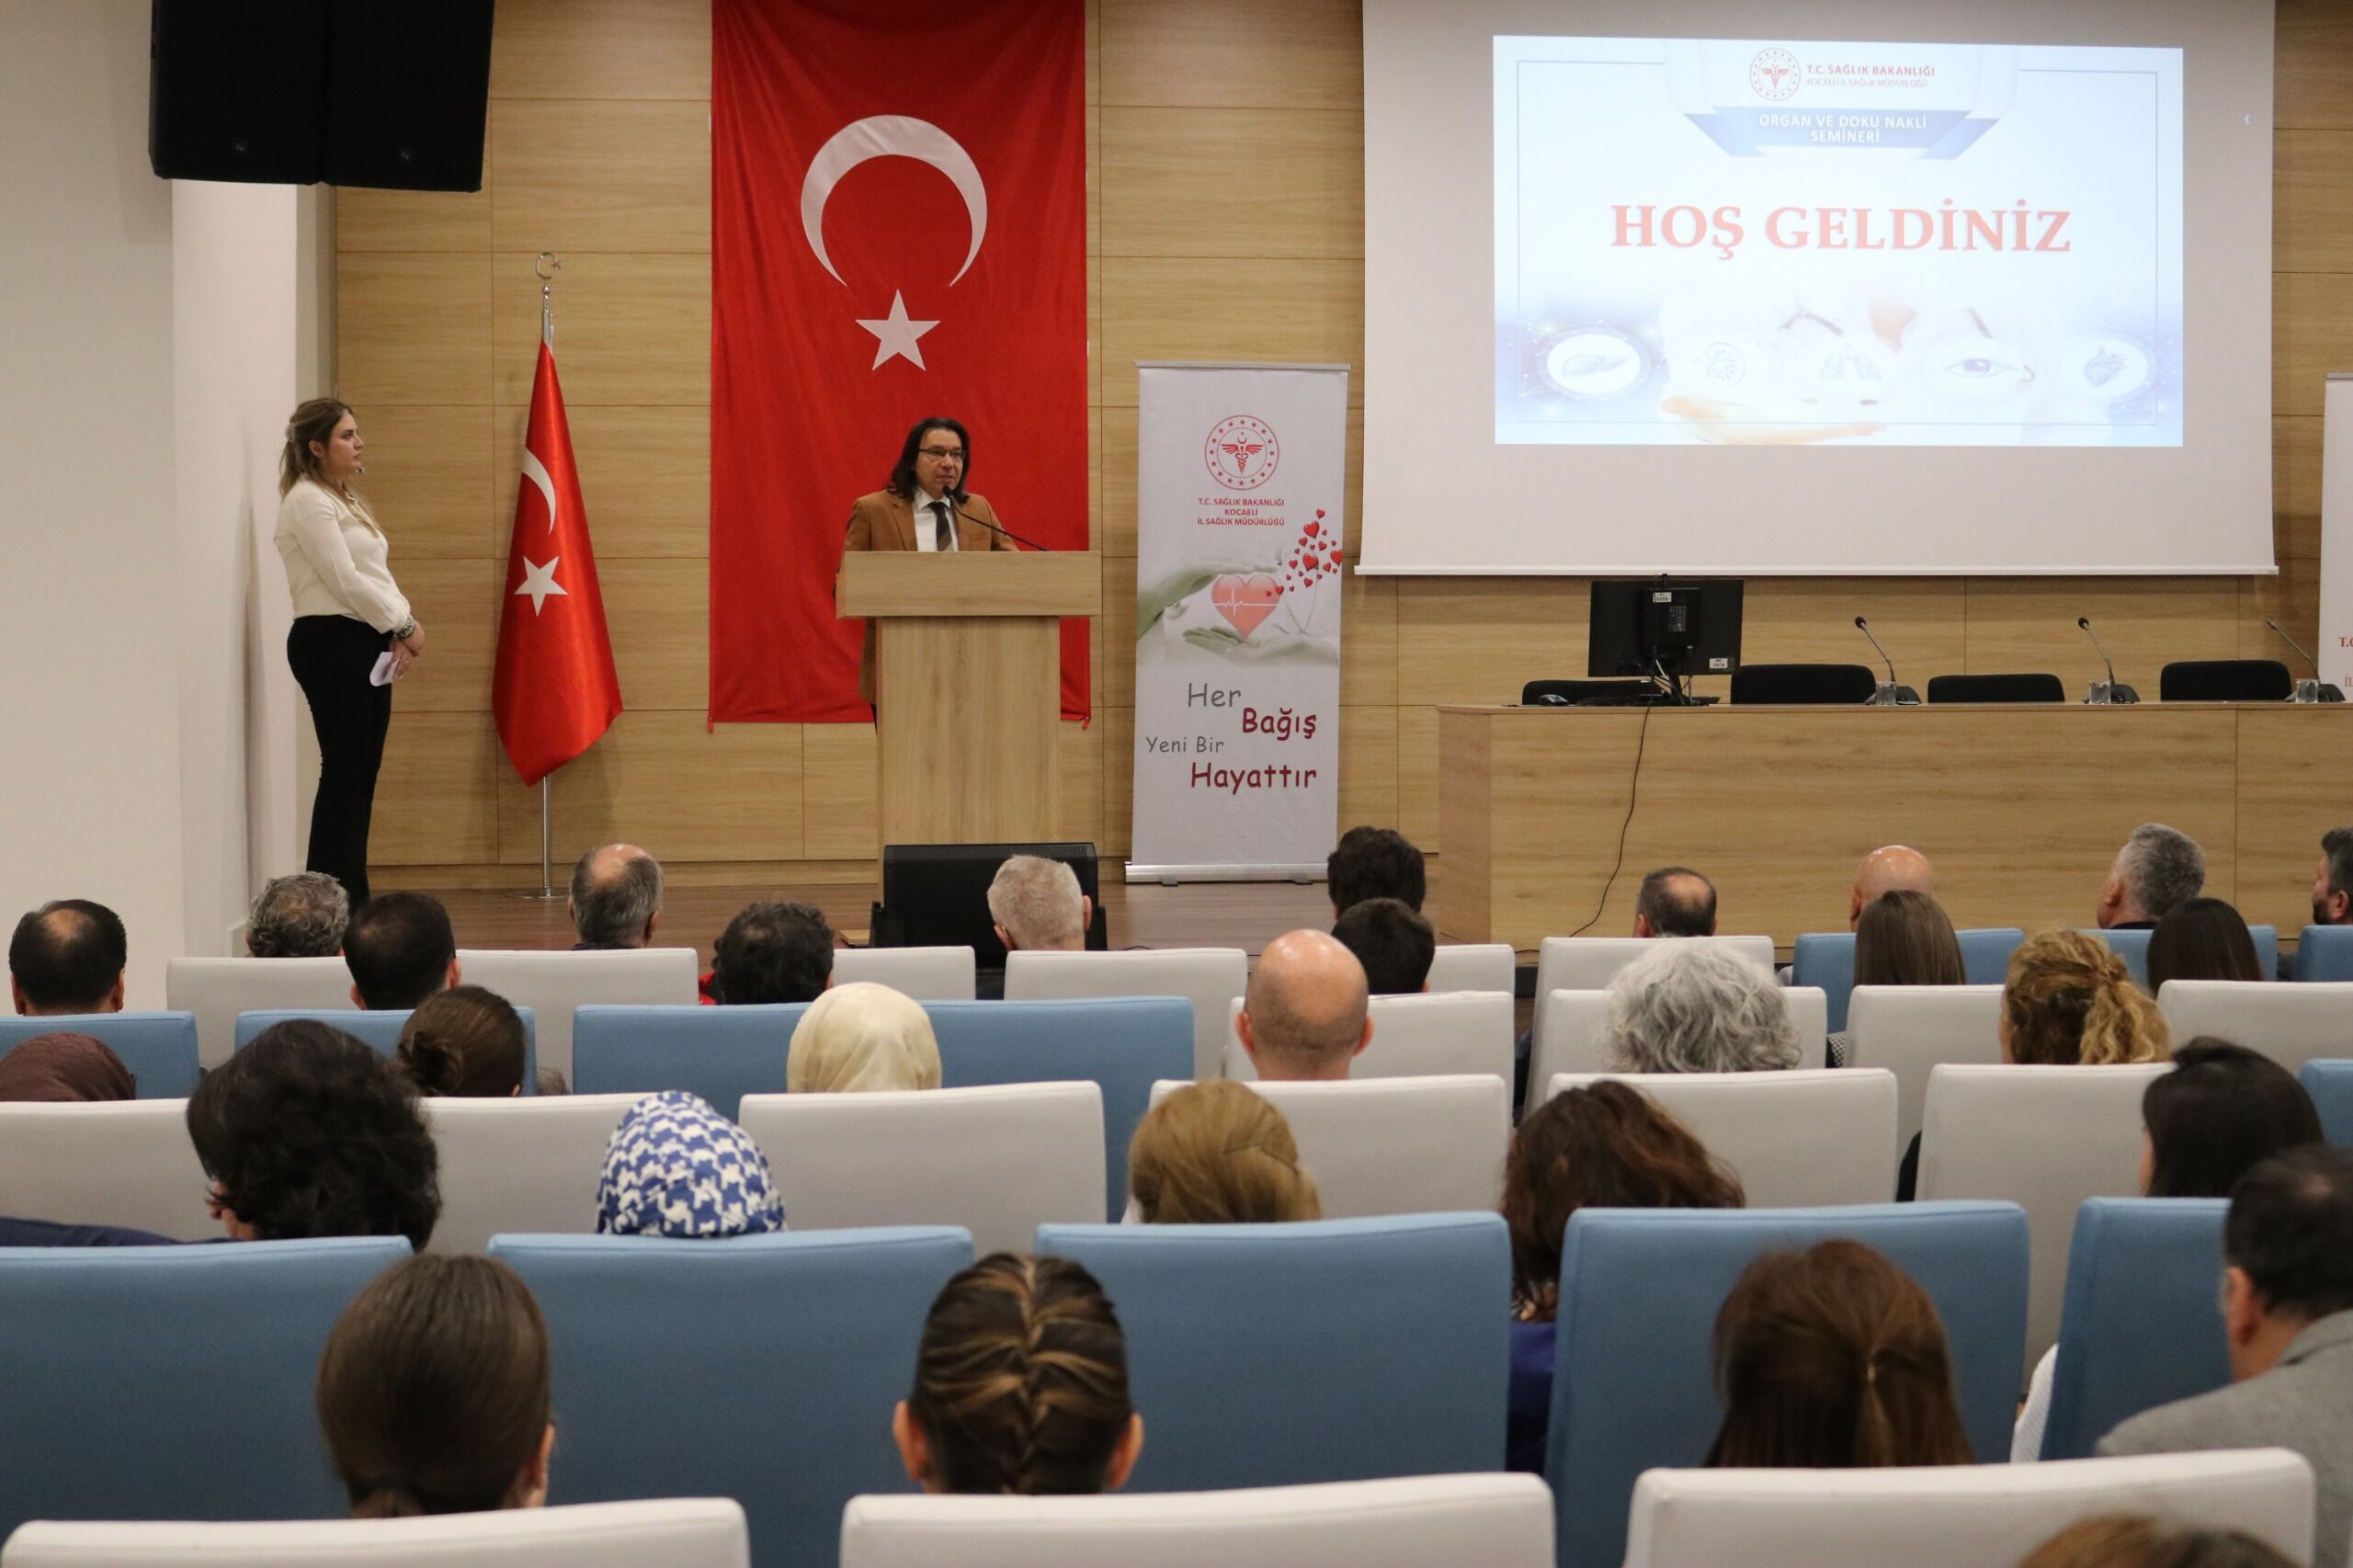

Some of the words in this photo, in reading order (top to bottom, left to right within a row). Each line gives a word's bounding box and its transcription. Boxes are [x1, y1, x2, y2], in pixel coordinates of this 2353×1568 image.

[1806, 64, 1825, 74] T.C.
[1827, 63, 1869, 75] SAĞLIK
[1872, 65, 1935, 76] BAKANLIĞI
[1758, 113, 1811, 127] ORGAN
[1816, 115, 1834, 128] VE
[1838, 116, 1880, 129] DOKU
[1885, 114, 1927, 130] NAKLİ
[1811, 129, 1880, 143] SEMİNERİ
[1610, 204, 1745, 260] HOŞ
[1765, 198, 2073, 253] GELDİNİZ
[1213, 497, 1241, 506] SAĞLIK
[1242, 498, 1285, 506] BAKANLIĞI
[1224, 507, 1258, 516] KOCAELİ
[1197, 517, 1204, 525] İL
[1205, 517, 1233, 525] SAĞLIK
[1234, 517, 1285, 527] MÜDÜRLÜĞÜ
[1188, 682, 1241, 708] Her
[1242, 707, 1317, 742] Bağış
[1145, 735, 1187, 754] Yeni
[1196, 735, 1224, 754] Bir
[1190, 761, 1317, 795] Hayattır
